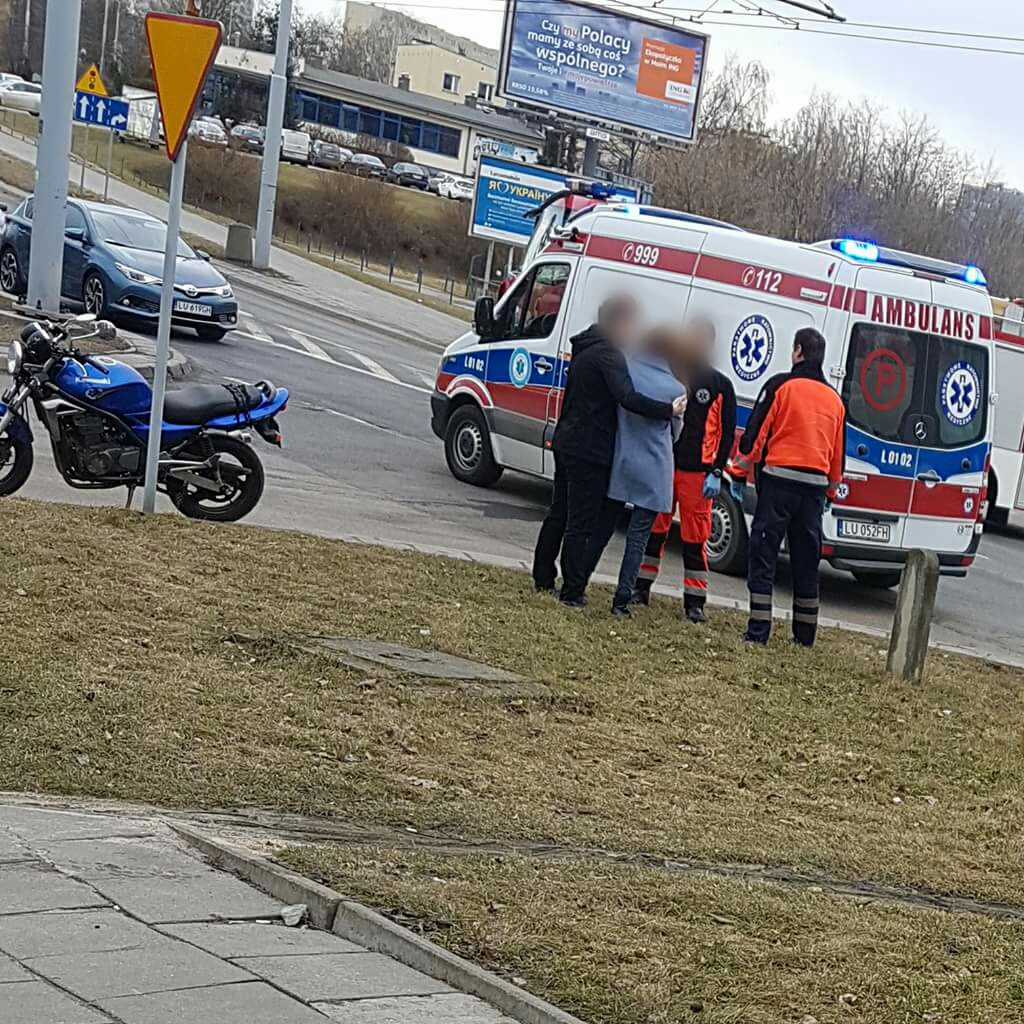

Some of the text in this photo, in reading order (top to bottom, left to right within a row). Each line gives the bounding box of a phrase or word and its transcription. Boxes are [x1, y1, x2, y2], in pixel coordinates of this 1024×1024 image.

[527, 31, 622, 61] mamy ze sobą coś
[541, 19, 560, 35] Czy
[581, 25, 631, 54] Polacy
[536, 47, 626, 78] wspólnego?
[633, 244, 660, 266] 999
[755, 269, 783, 293] 112
[871, 295, 975, 340] AMBULANS
[874, 363, 897, 398] P
[881, 449, 887, 464] L
[844, 521, 889, 539] LU 052FH
